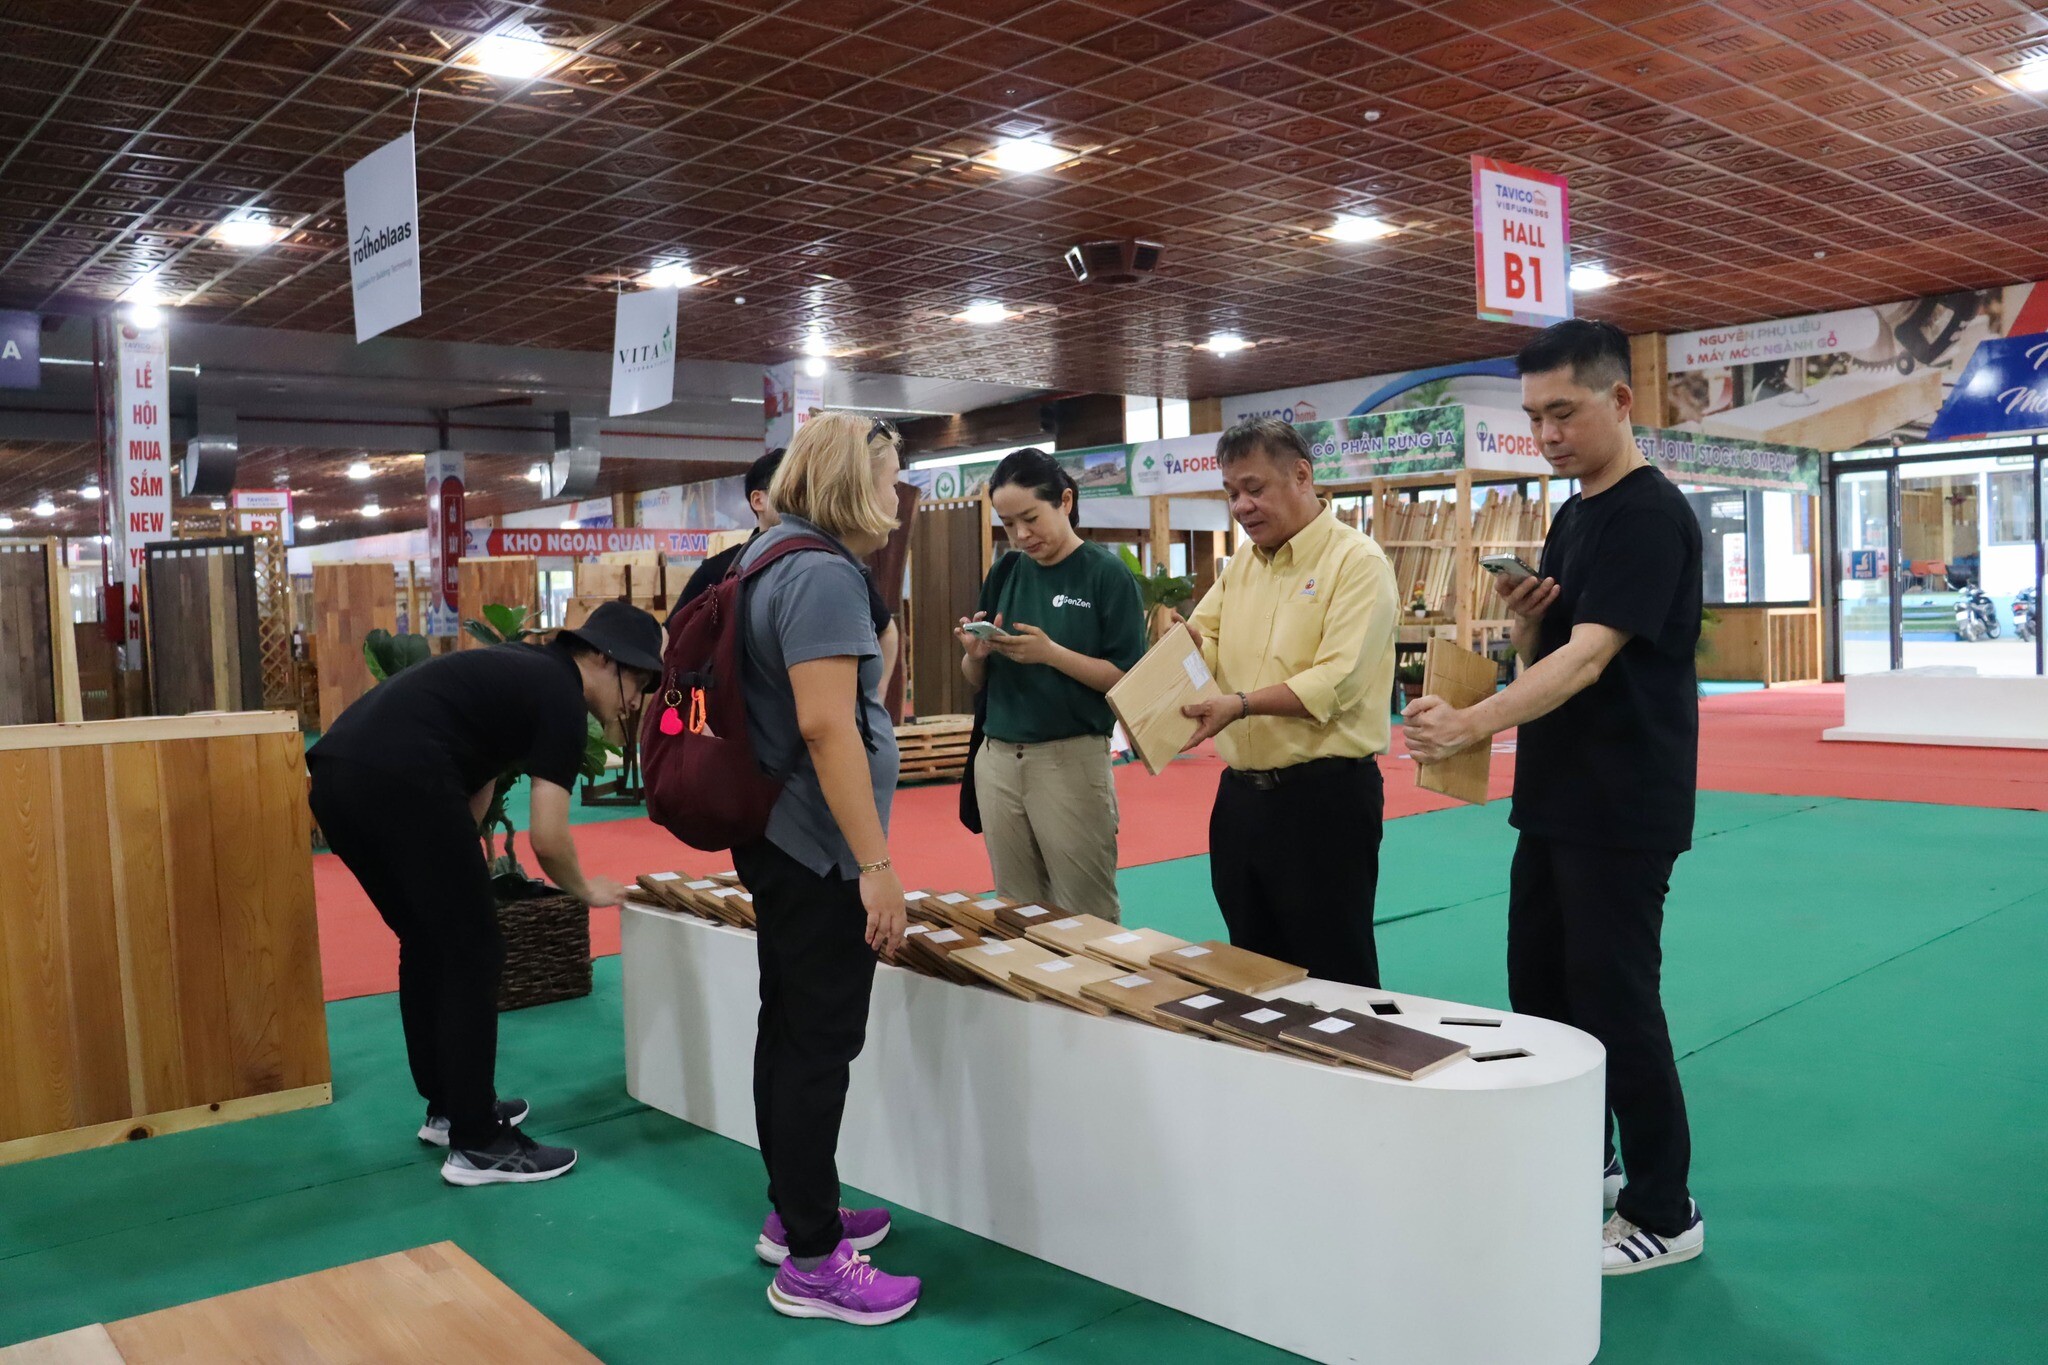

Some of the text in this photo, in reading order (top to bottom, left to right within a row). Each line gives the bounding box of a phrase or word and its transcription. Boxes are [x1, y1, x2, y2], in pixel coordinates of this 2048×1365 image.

[1495, 184, 1533, 204] TAVICO
[1496, 201, 1549, 220] VIEFURN365
[353, 221, 412, 266] rothoblaas
[1503, 219, 1546, 248] HALL
[1504, 252, 1543, 303] B1
[1757, 324, 1787, 340] PHỤ
[1, 340, 22, 360] A
[1685, 330, 1838, 366] & MÁY MÓC NGÀNH GỖ
[135, 361, 153, 389] LỄ
[132, 400, 157, 430] HỘI
[129, 440, 162, 461] MUA
[1341, 431, 1383, 455] PHẦN
[1387, 432, 1433, 452] RỪNG
[1436, 429, 1457, 446] TA
[1476, 425, 1541, 457] TAFORES
[1658, 439, 1696, 463] JOINT
[1698, 445, 1741, 468] STOCK
[1163, 455, 1220, 475] TAFORE
[130, 469, 163, 497] SẮM
[130, 512, 164, 533] NEW
[502, 533, 542, 552] KHO
[547, 533, 603, 556] NGOẠI
[607, 533, 655, 552] QUAN
[669, 534, 709, 552] TAVI
